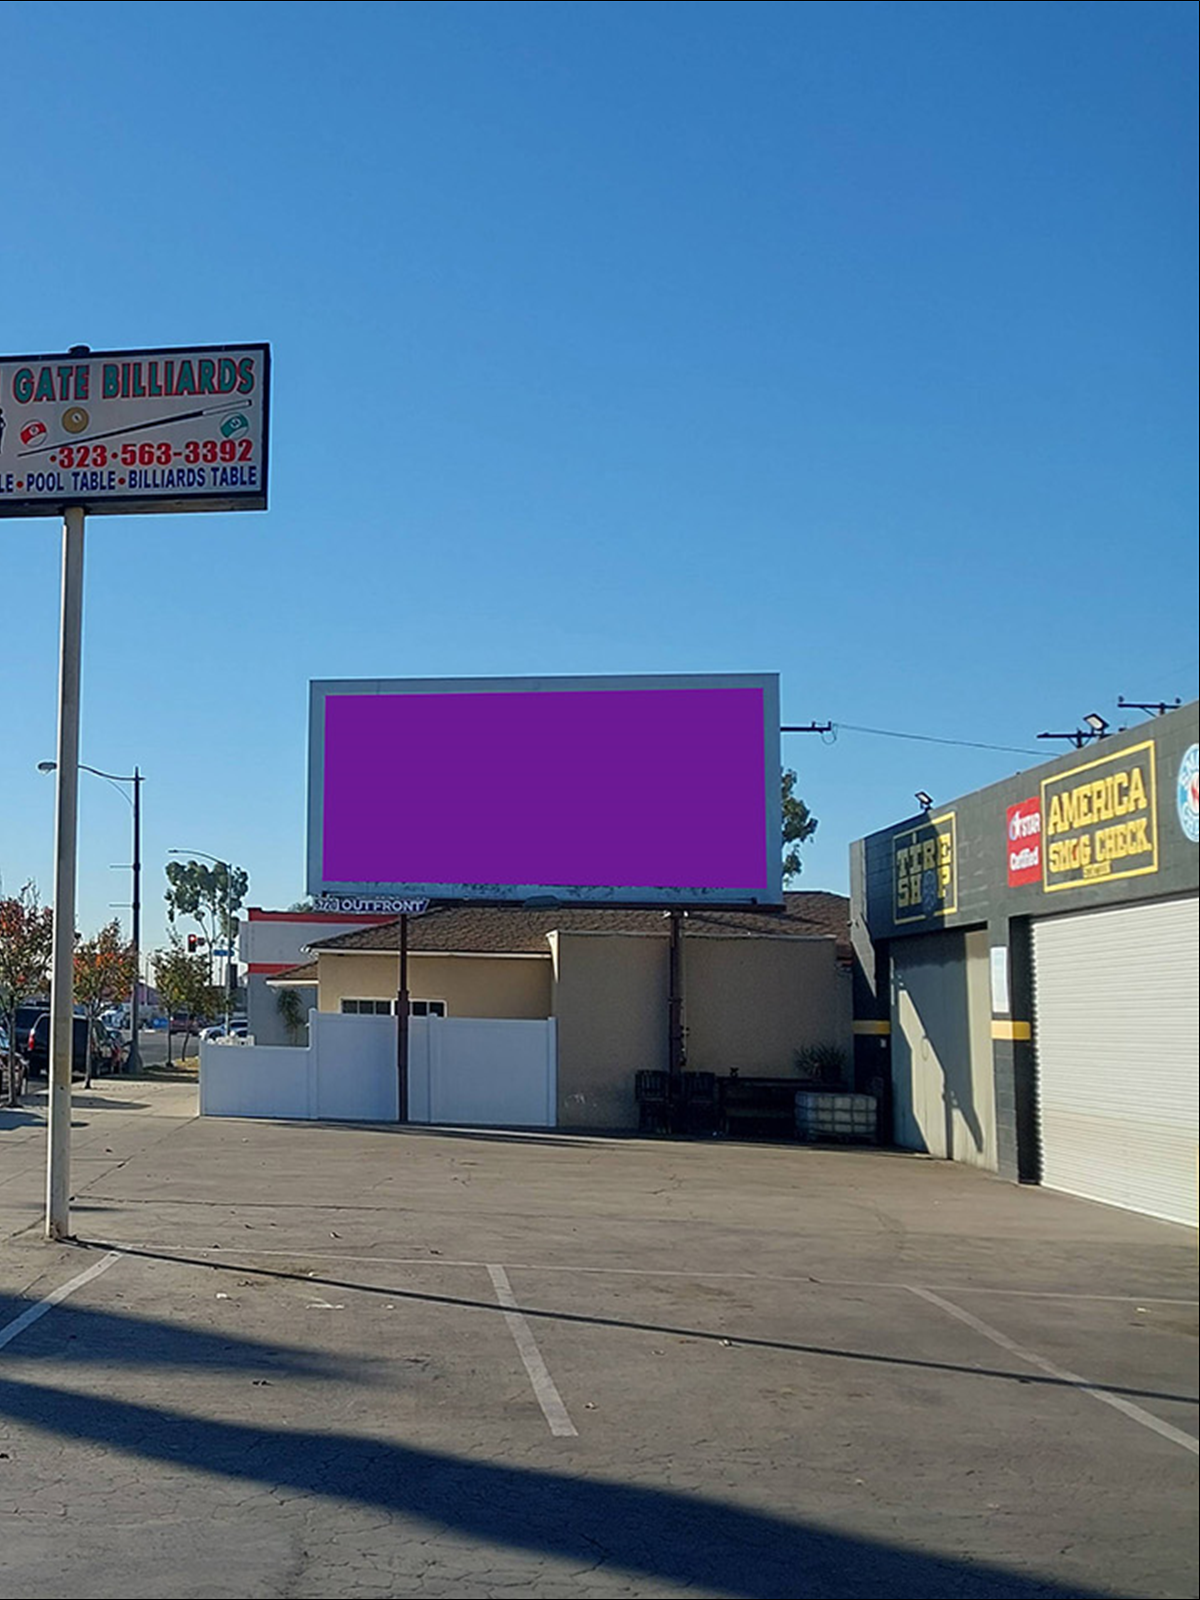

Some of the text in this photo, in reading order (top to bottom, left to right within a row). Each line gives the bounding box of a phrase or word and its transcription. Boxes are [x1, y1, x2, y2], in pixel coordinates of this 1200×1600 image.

[13, 364, 90, 404] GATE
[103, 356, 255, 399] BILLIARDS
[26, 472, 64, 492] POOL
[72, 470, 116, 491] TABLE
[128, 468, 206, 490] BILLIARDS
[211, 465, 257, 487] TABLE
[1047, 767, 1148, 836] AMERICA
[897, 833, 951, 879] TIRE
[1049, 834, 1091, 873] SMOG
[1095, 817, 1152, 862] CHECK
[341, 899, 424, 912] OUTFRONT
